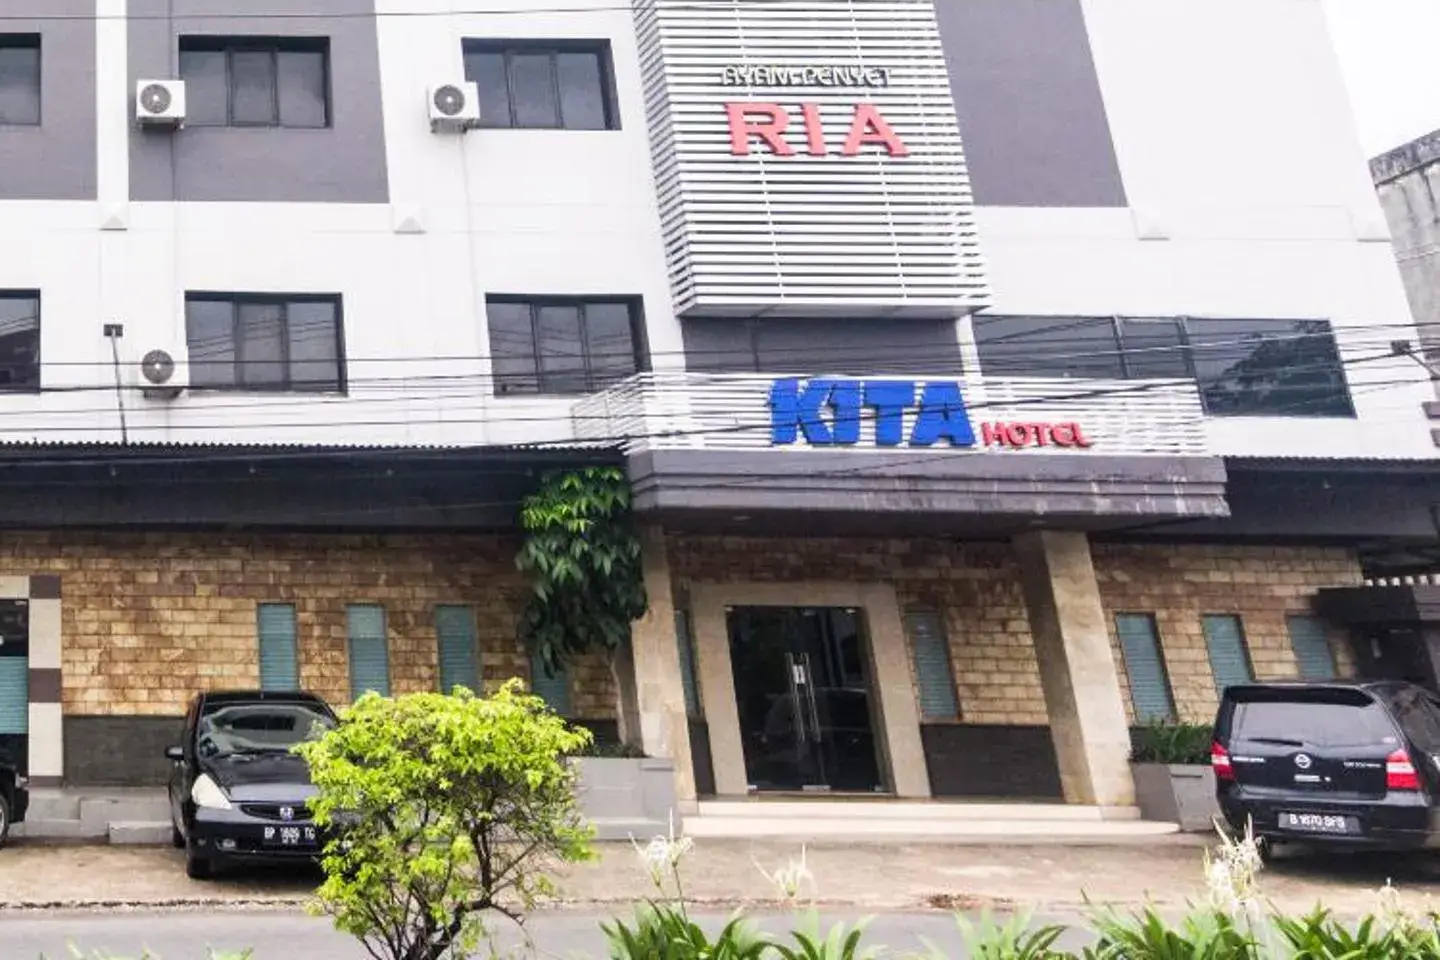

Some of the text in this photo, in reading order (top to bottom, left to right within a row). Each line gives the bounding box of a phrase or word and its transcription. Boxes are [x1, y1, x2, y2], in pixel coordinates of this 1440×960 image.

[721, 65, 890, 88] AYAM PENYET
[724, 102, 910, 157] RIA
[769, 379, 1092, 449] KITA HOTEL
